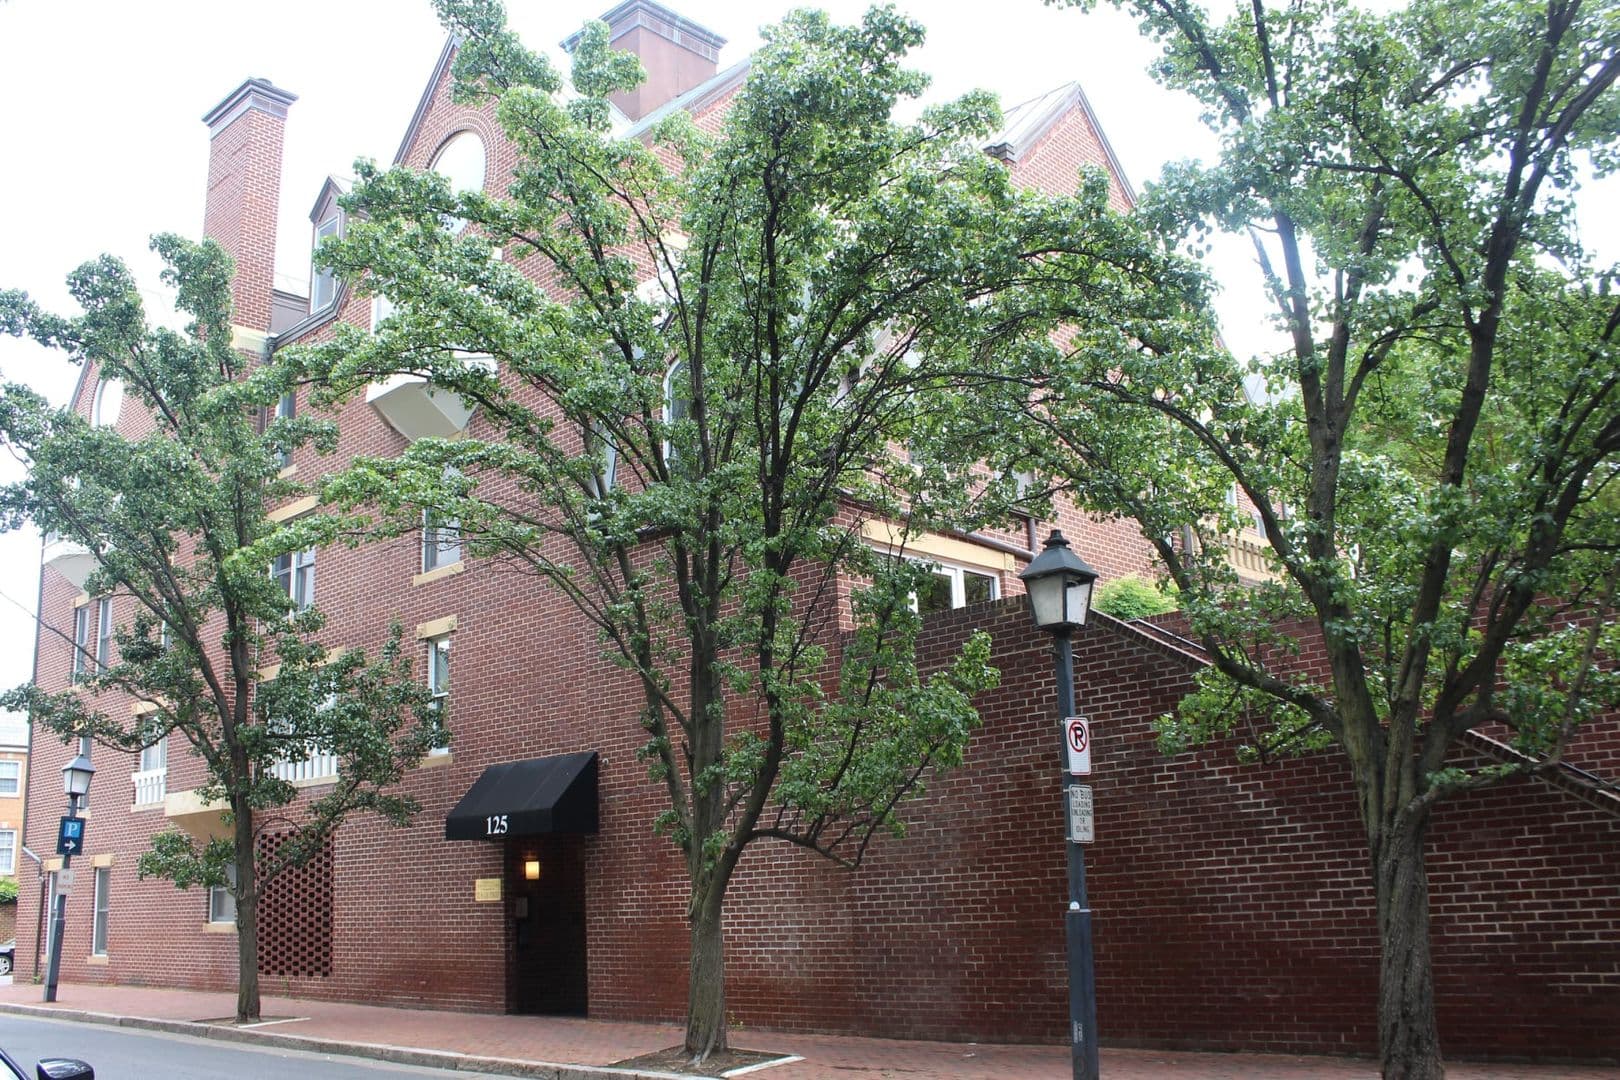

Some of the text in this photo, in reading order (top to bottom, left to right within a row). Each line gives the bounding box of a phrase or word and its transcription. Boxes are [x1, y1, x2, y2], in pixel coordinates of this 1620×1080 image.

[1071, 789, 1092, 800] NO BUS
[1072, 800, 1091, 808] LOADING
[1072, 808, 1093, 817] UNLOADING
[67, 822, 78, 837] P
[486, 815, 508, 835] 125
